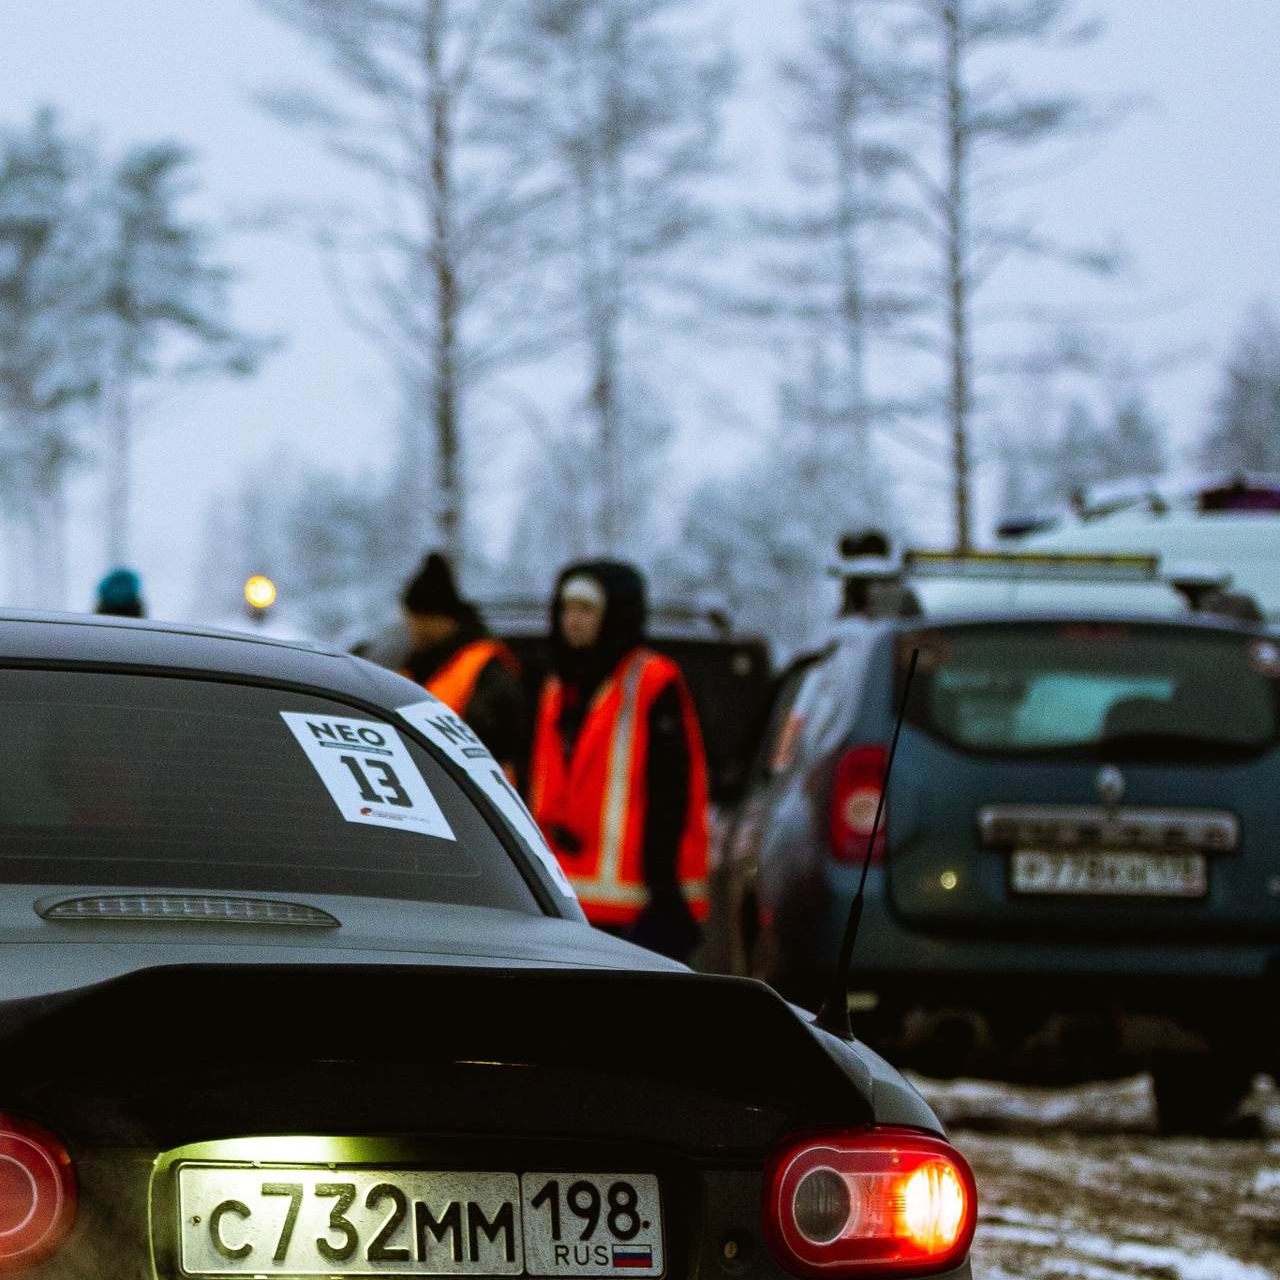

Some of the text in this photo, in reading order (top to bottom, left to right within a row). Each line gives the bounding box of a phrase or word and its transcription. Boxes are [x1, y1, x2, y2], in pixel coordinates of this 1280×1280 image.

[305, 720, 386, 748] NEO
[424, 714, 480, 746] NE
[340, 755, 414, 809] 13
[530, 1180, 642, 1242] 198
[554, 1244, 609, 1267] RUS
